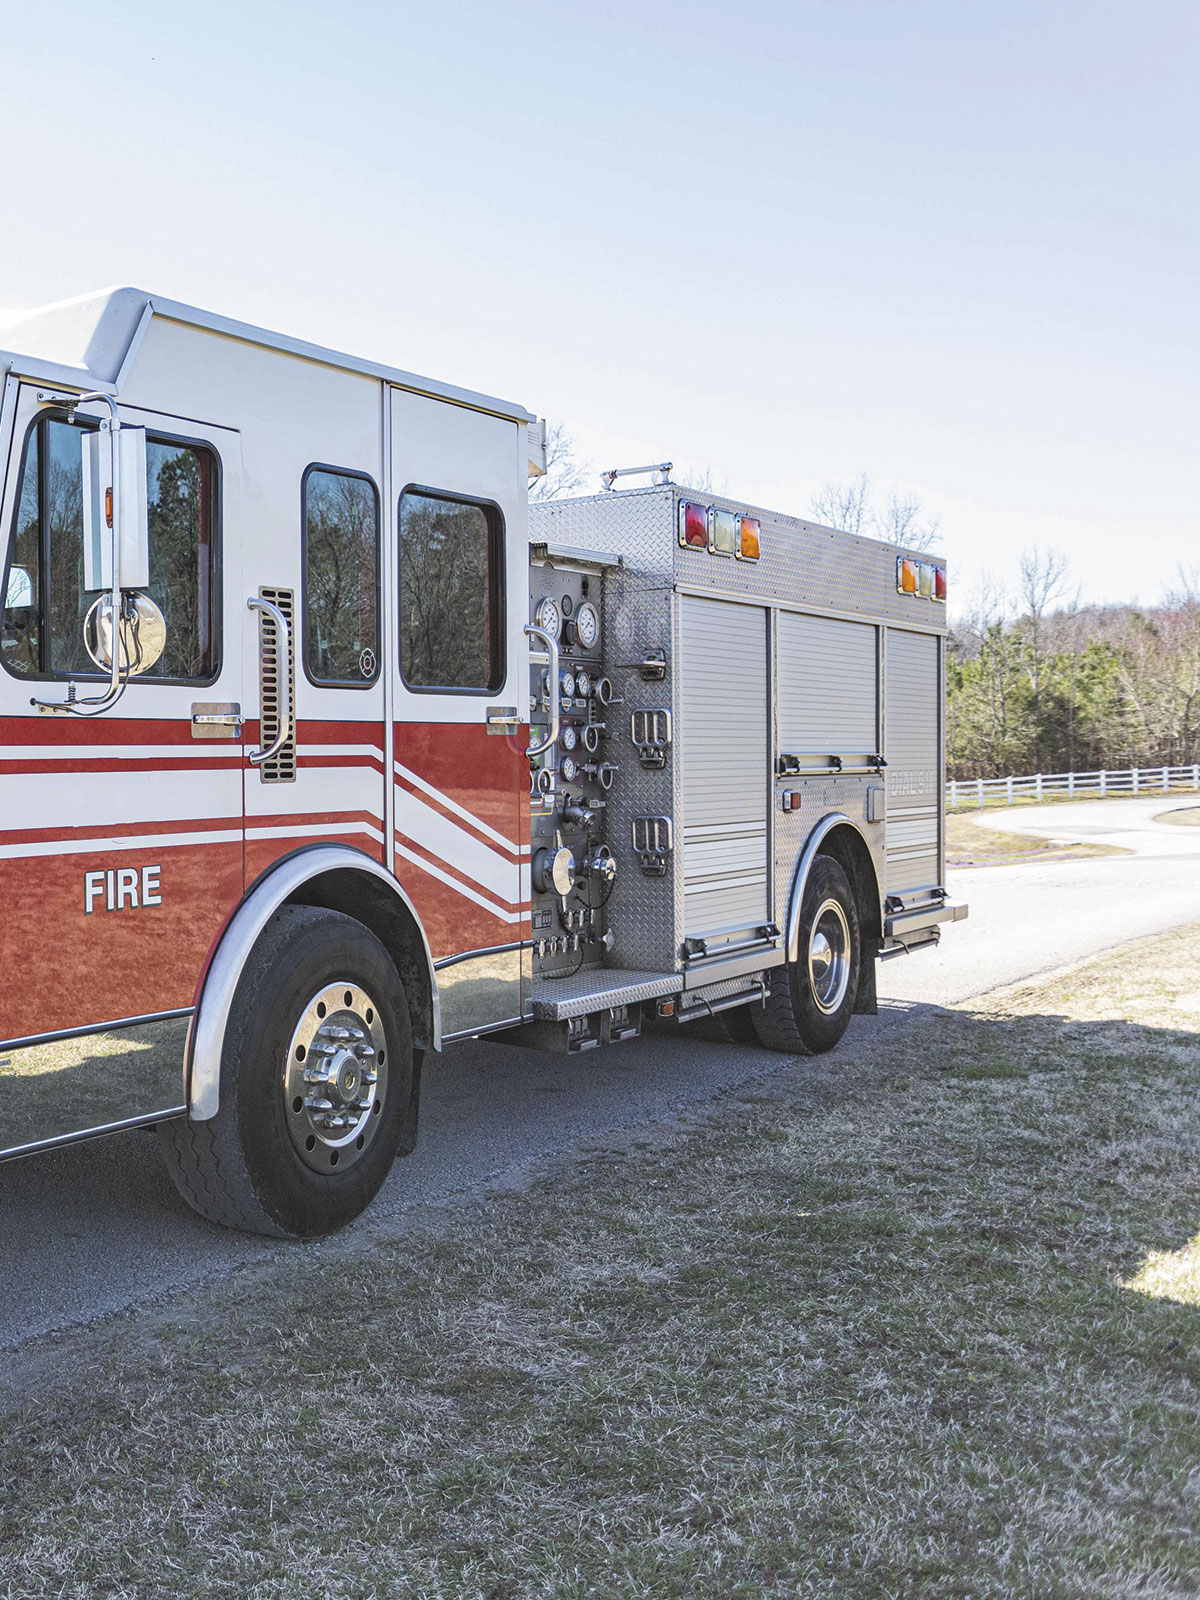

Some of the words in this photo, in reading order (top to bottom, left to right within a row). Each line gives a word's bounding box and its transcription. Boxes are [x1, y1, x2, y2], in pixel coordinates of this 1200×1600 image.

[891, 771, 916, 796] DIAL
[919, 770, 933, 795] 911
[84, 864, 162, 915] FIRE
